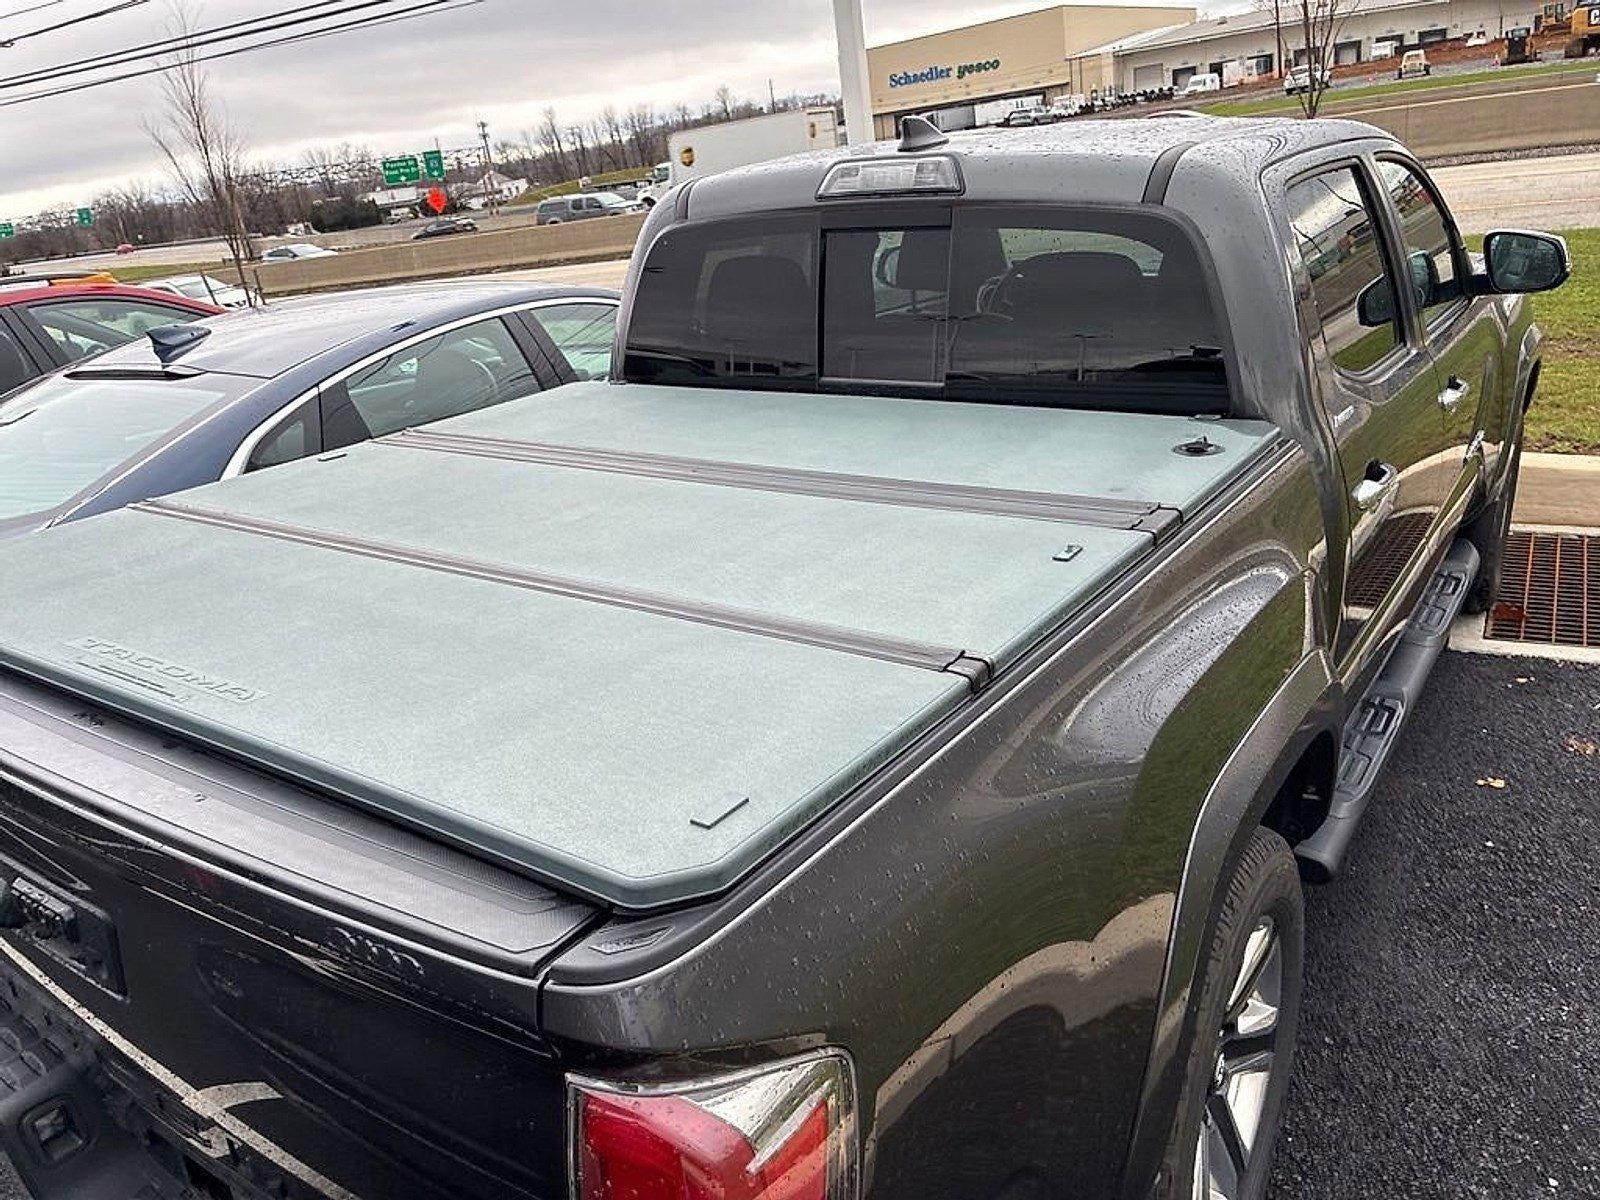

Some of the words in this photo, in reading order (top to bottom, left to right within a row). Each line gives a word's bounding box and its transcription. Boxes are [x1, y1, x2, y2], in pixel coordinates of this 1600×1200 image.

[889, 66, 952, 88] Schaedler
[956, 59, 1000, 79] yesco
[82, 638, 258, 701] TACOMA
